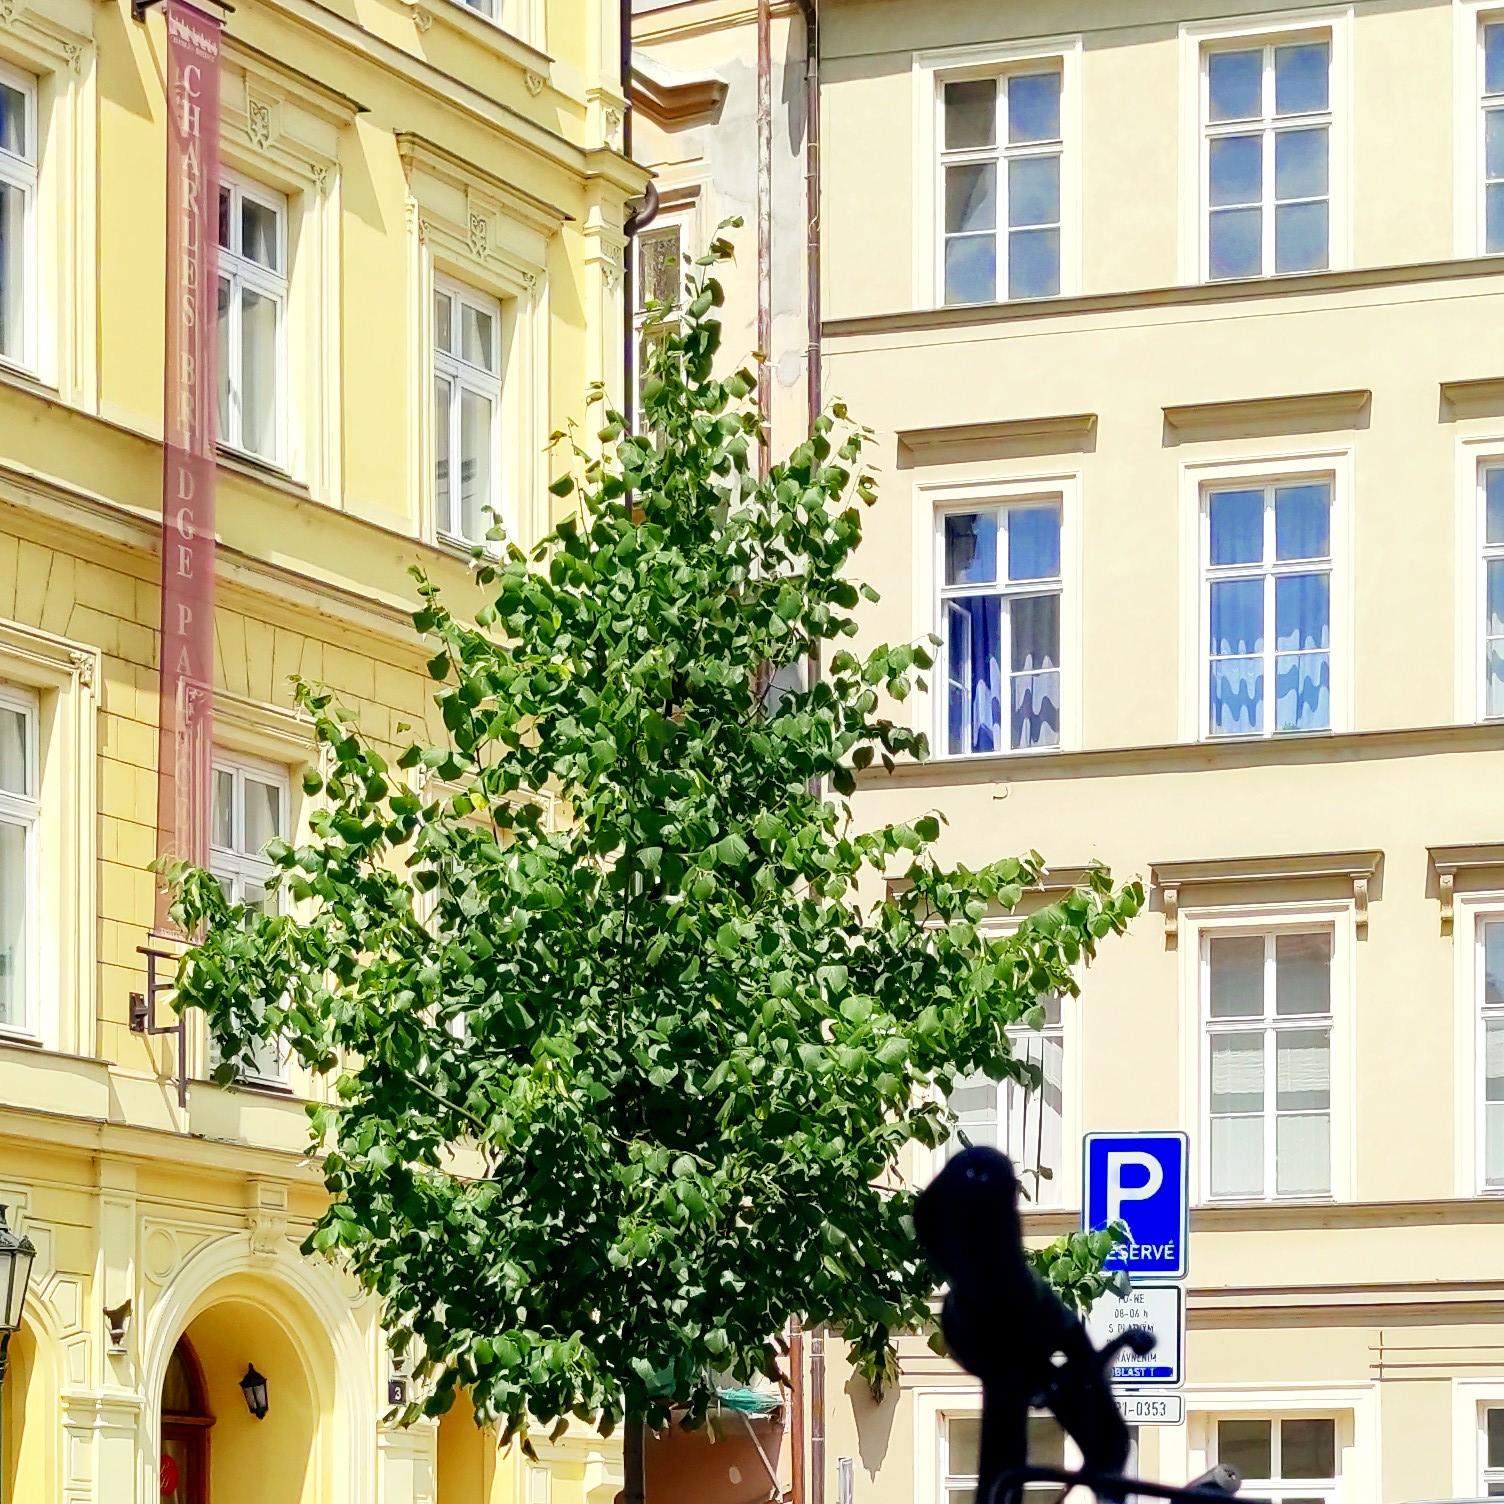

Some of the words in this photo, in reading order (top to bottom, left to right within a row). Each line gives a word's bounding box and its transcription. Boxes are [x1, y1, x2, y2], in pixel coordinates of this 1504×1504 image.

[181, 64, 202, 327] CHARLES
[176, 351, 198, 579] BRIDGE
[1107, 1151, 1164, 1224] P
[394, 1386, 402, 1401] 3
